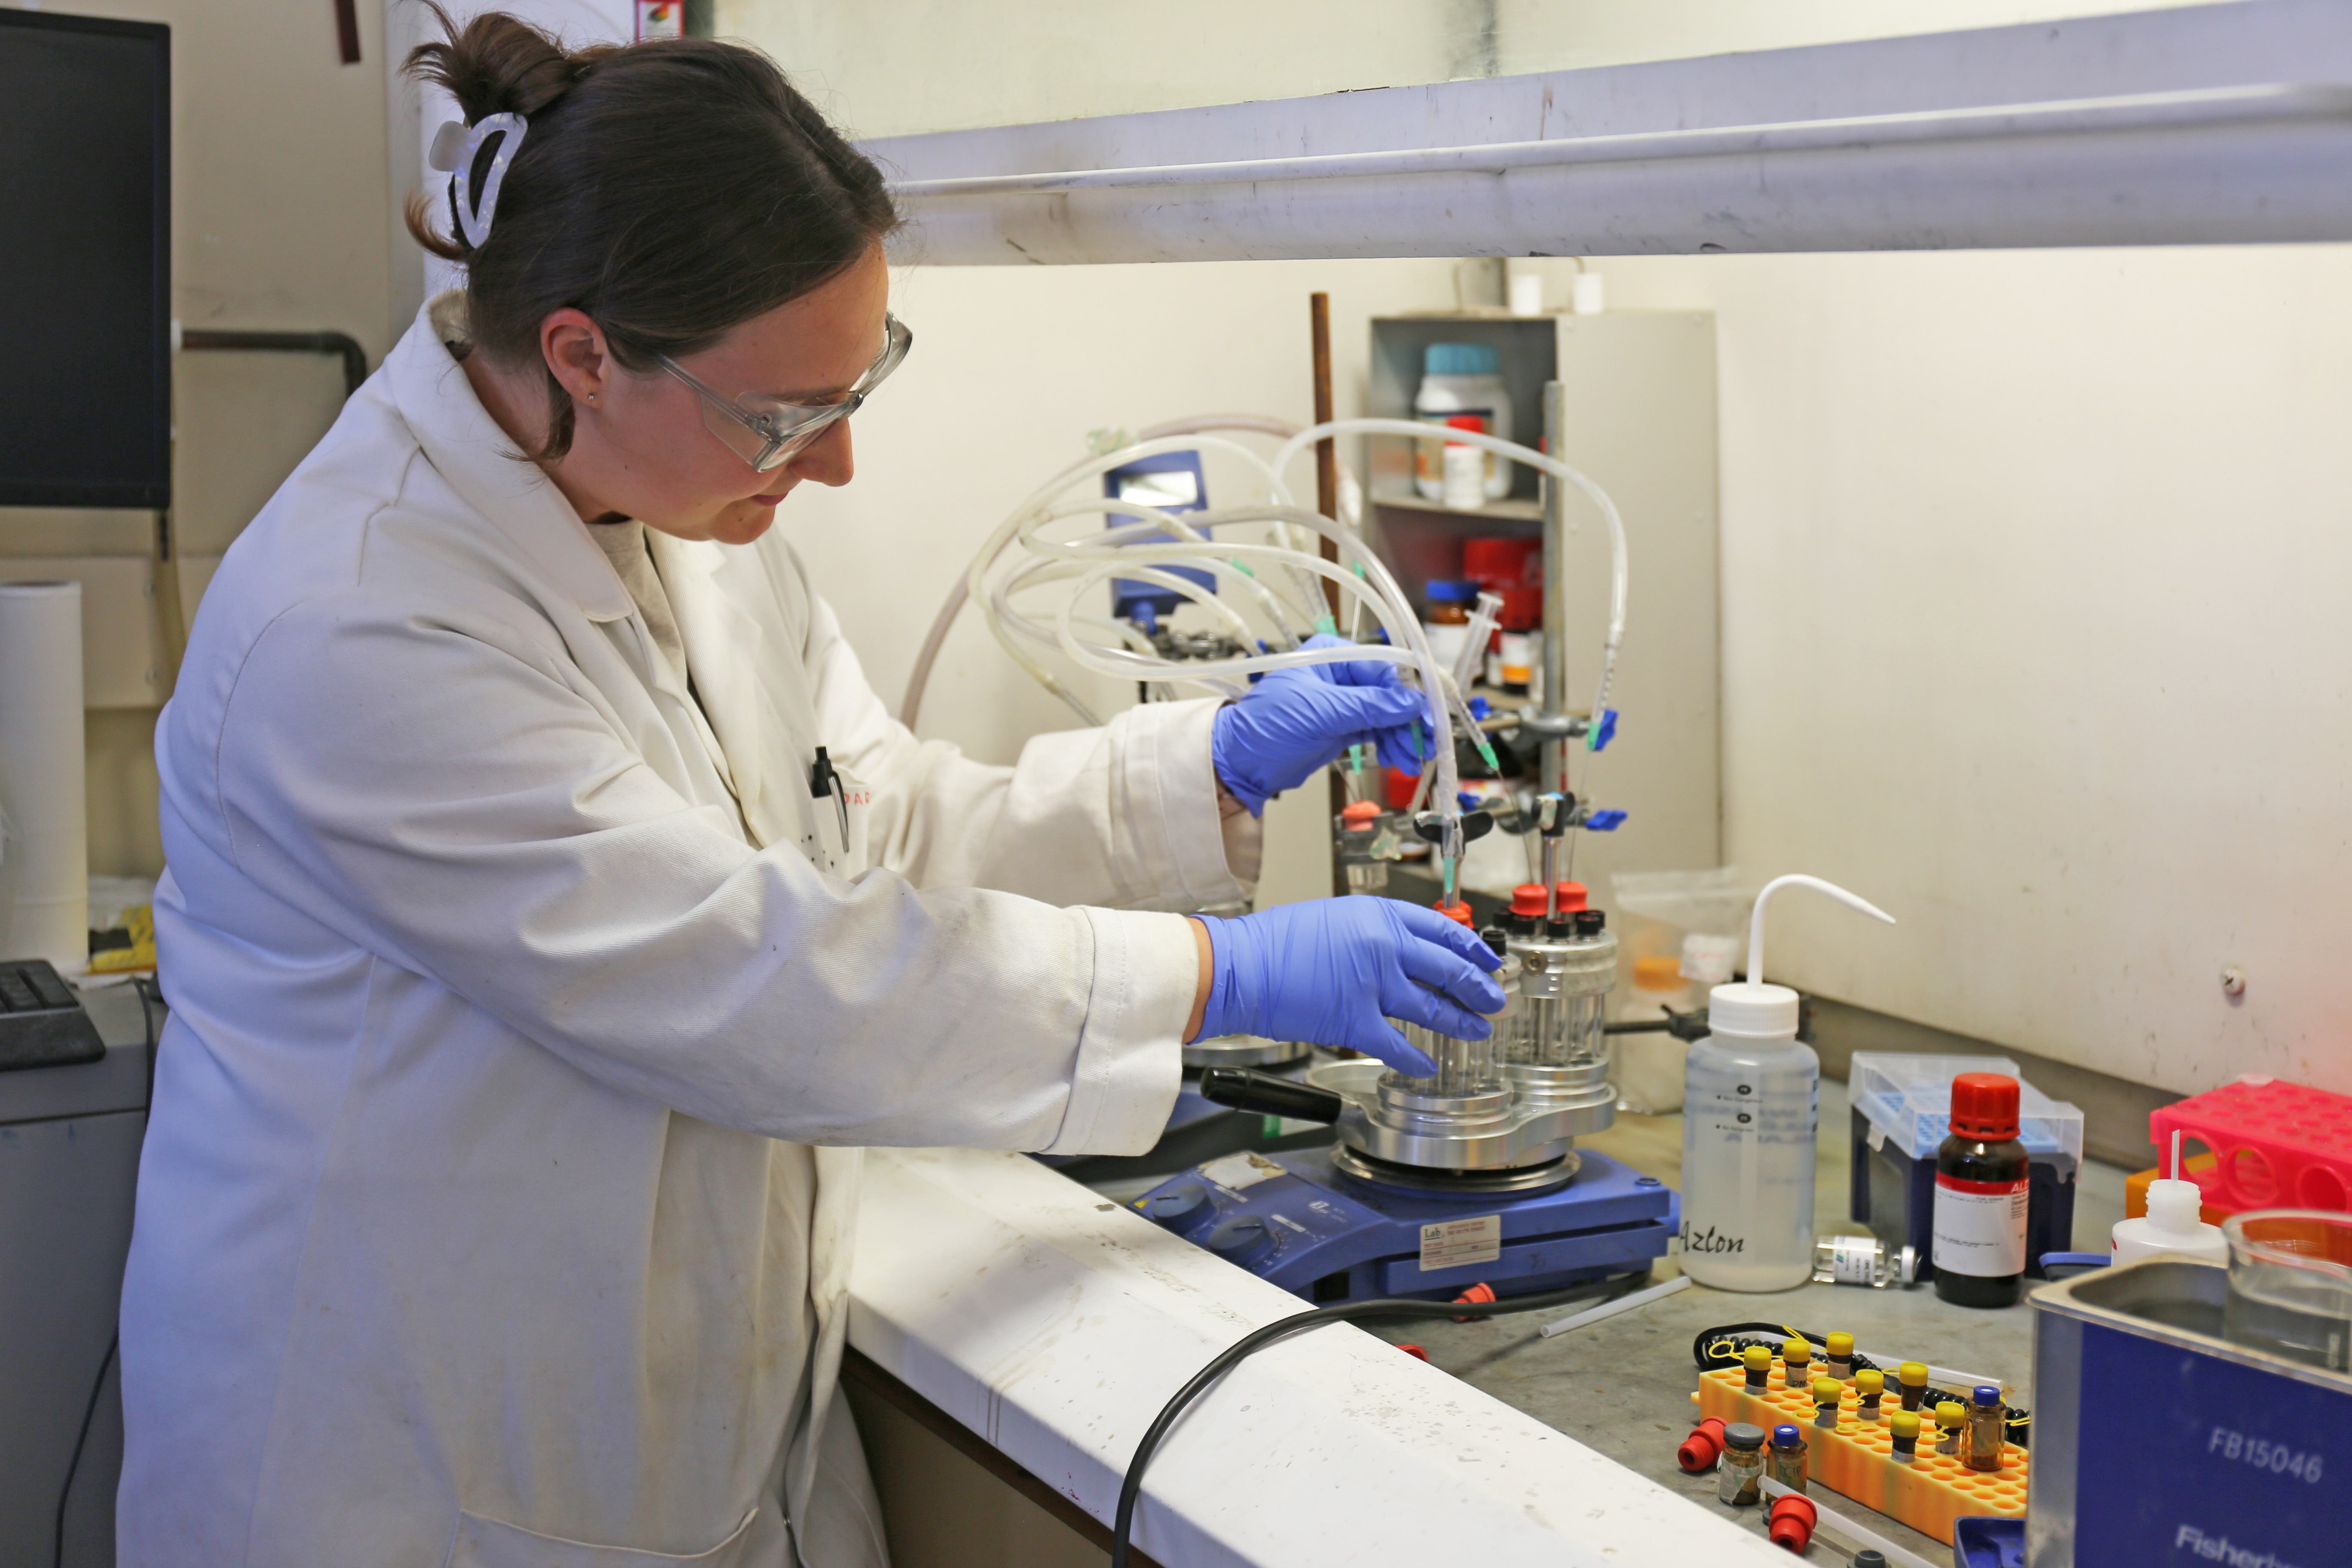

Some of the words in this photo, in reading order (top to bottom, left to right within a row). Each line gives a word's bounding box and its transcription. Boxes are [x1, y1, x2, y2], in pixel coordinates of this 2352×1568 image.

[1424, 1227, 1441, 1238] Lab
[1679, 1220, 1744, 1253] Azlon
[2208, 1426, 2324, 1484] FB15046
